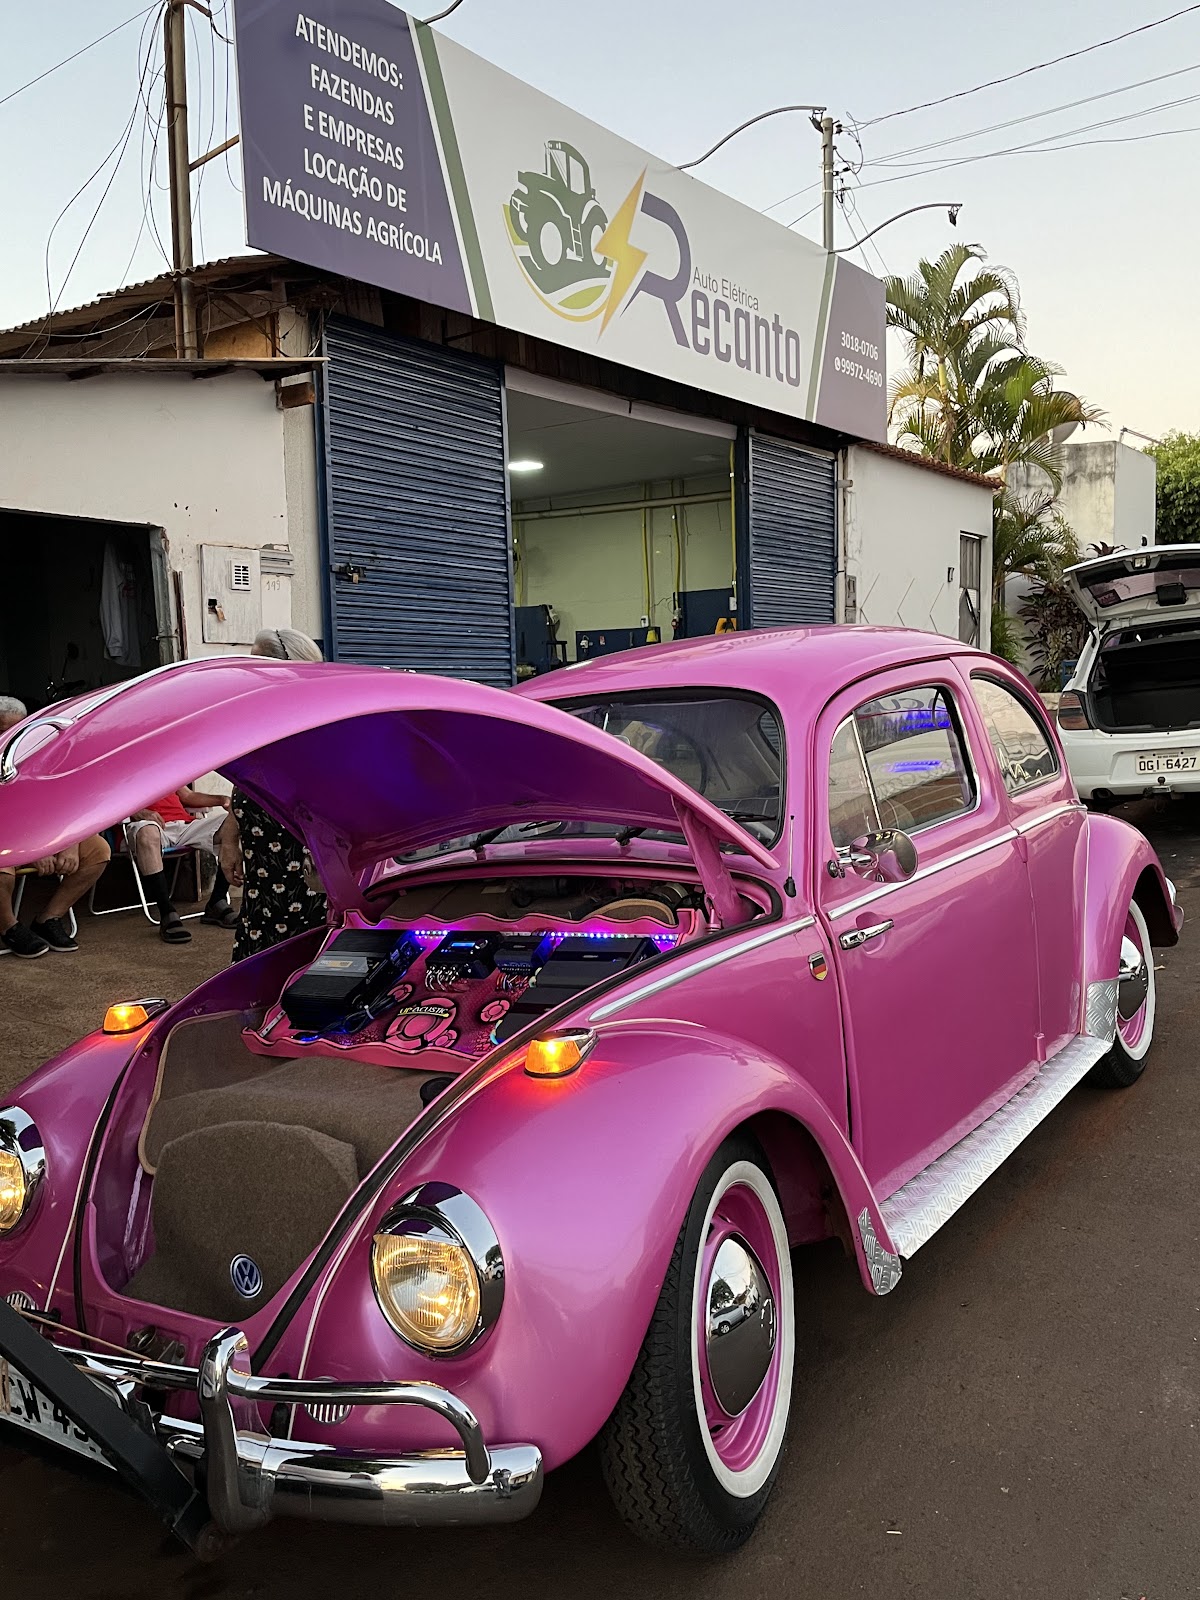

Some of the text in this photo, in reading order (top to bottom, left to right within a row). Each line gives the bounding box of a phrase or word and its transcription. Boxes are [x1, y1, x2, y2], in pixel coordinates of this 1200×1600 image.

[295, 13, 404, 90] ATENDEMOS:
[310, 63, 395, 126] FAZENDAS
[303, 104, 404, 171] E EMPRESAS
[304, 148, 407, 213] LOCAÇÃO DE
[263, 176, 443, 266] MÁQUINAS AGRÍCOLA
[620, 191, 801, 388] Recanto
[692, 266, 760, 312] Auto Elétrica
[841, 331, 879, 361] 3018-0706
[841, 357, 883, 388] 99972-4690
